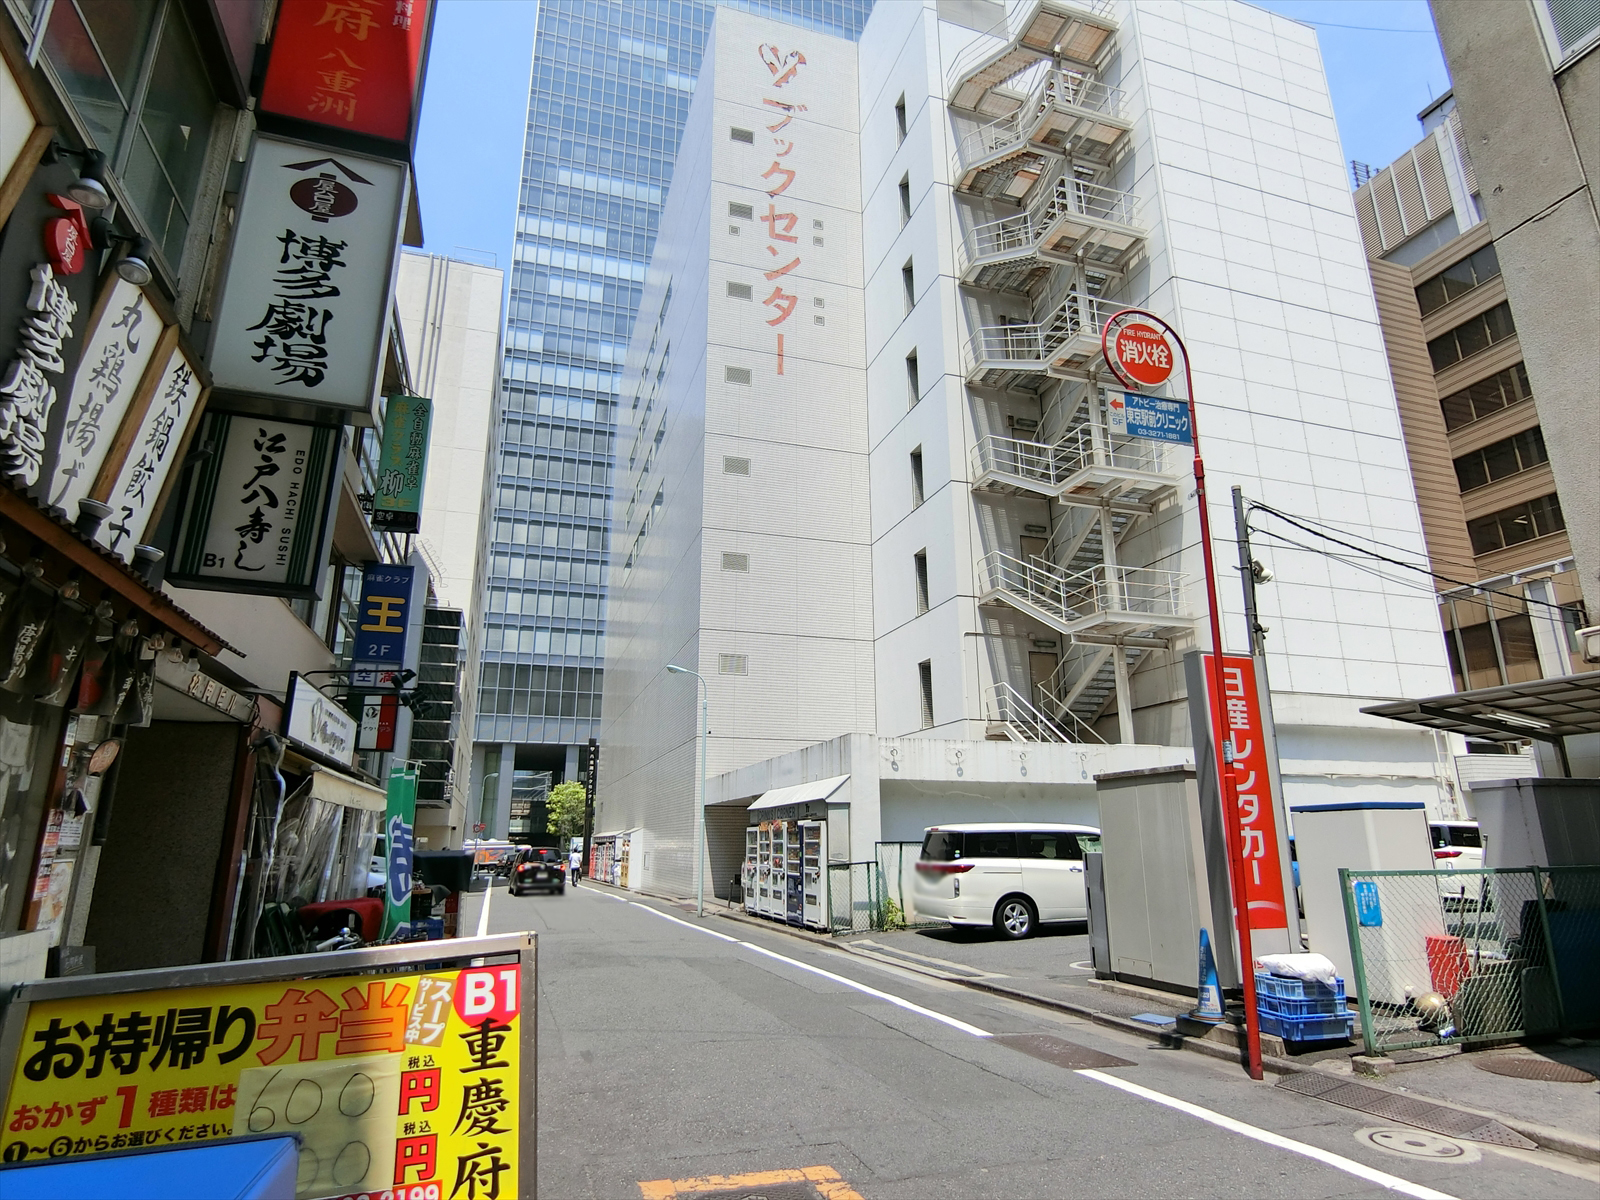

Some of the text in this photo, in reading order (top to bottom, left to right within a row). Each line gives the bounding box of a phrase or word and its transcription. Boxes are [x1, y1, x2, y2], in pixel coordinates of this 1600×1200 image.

[313, 0, 385, 42] 府
[307, 47, 367, 122] 八重洲
[759, 97, 809, 377] ブックセンター
[245, 228, 349, 388] 博多劇場
[1120, 339, 1170, 369] 消火栓
[1123, 328, 1162, 341] FIRE HYDRANT
[48, 291, 144, 505] 丸鶏揚げ
[1126, 407, 1188, 432] 東京駅前クリニック
[1112, 418, 1124, 427] 5F
[405, 402, 429, 492] 全自動麻雀卓
[234, 428, 288, 572] 江戸八寿し
[380, 468, 406, 499] 柳
[381, 497, 413, 509] 3F
[275, 450, 306, 566] EDO HACHI SUSHI
[203, 552, 226, 569] B1
[366, 573, 411, 585] 麻雀クラブ
[361, 595, 406, 633] 王
[368, 644, 392, 656] 2F
[356, 667, 372, 683] 空
[1223, 667, 1265, 885] 日産レンタカー
[405, 977, 433, 1043] サービス中
[422, 981, 453, 1045] スープ
[464, 969, 517, 1016] B1
[407, 1054, 435, 1070] 税込
[246, 1068, 376, 1133] 600
[399, 1067, 442, 1116] 円
[448, 1017, 514, 1200] 重慶府
[403, 1120, 432, 1136] 税込
[393, 1133, 439, 1186] 円
